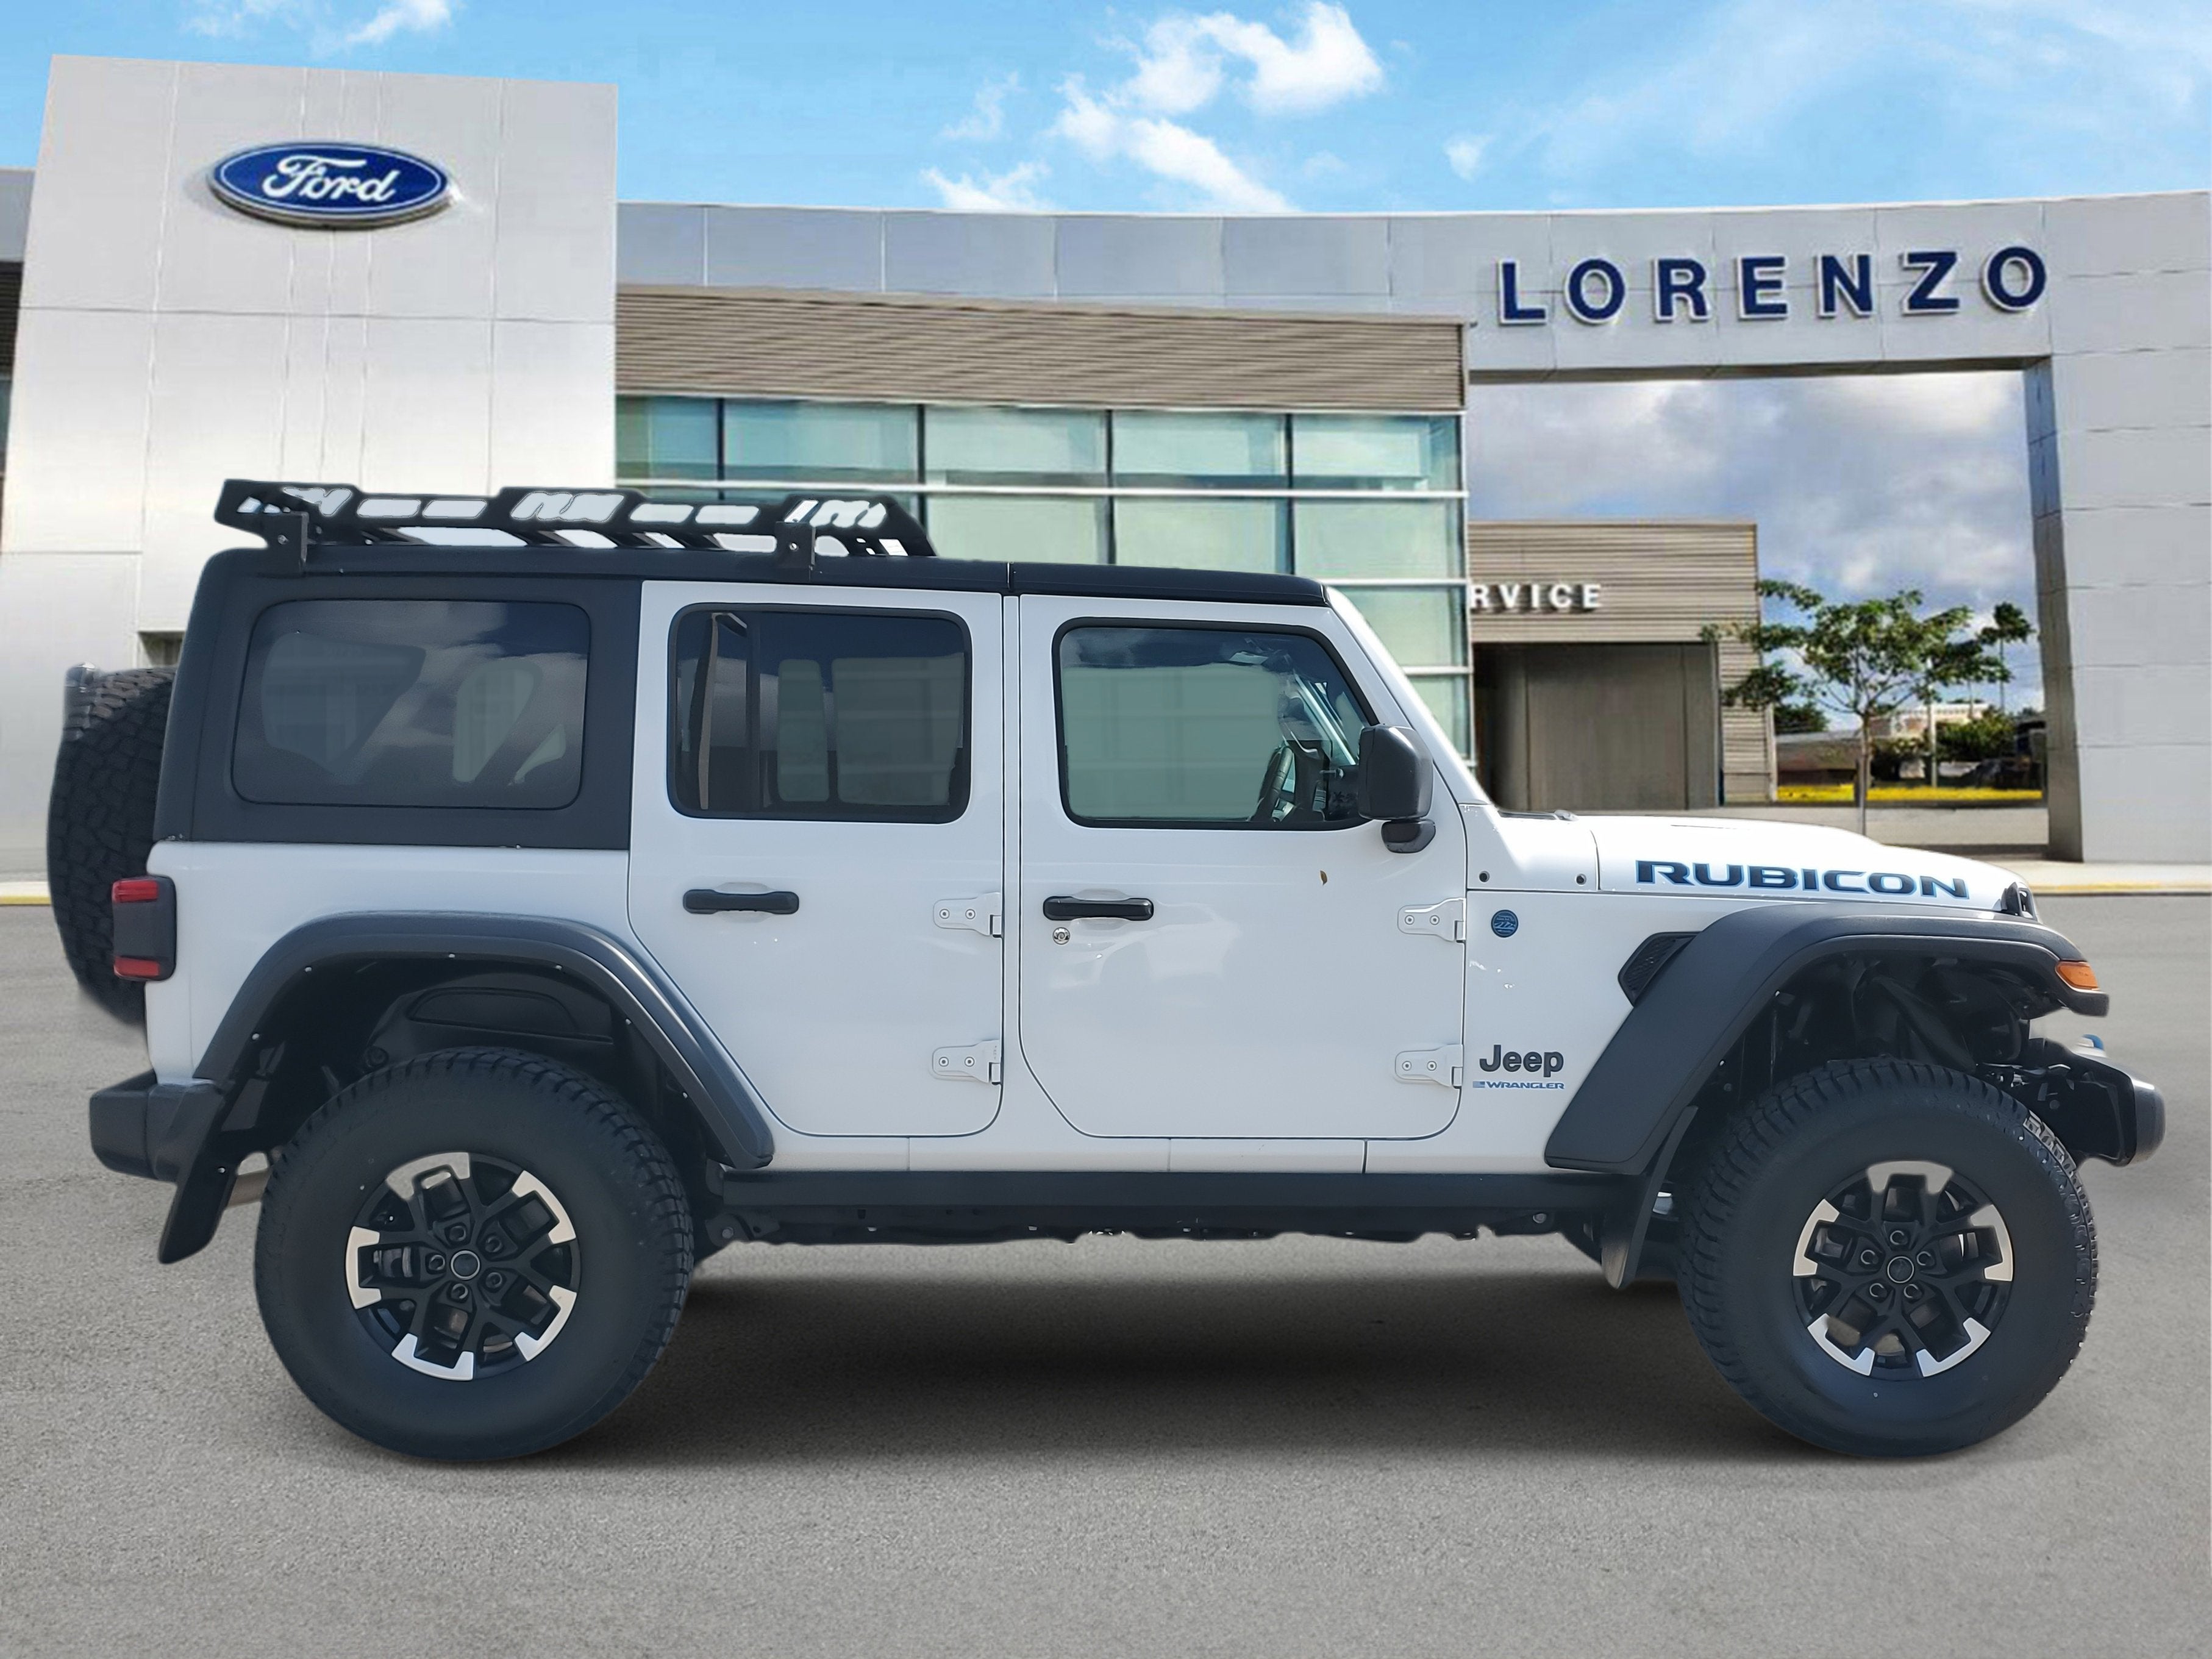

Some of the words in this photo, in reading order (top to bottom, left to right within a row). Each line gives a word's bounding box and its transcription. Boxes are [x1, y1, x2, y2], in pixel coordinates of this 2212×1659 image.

[262, 154, 401, 202] Ford
[1498, 246, 2046, 324] LORENZO
[1635, 860, 1969, 899] RUBICON
[1479, 1044, 1564, 1077] Jeep
